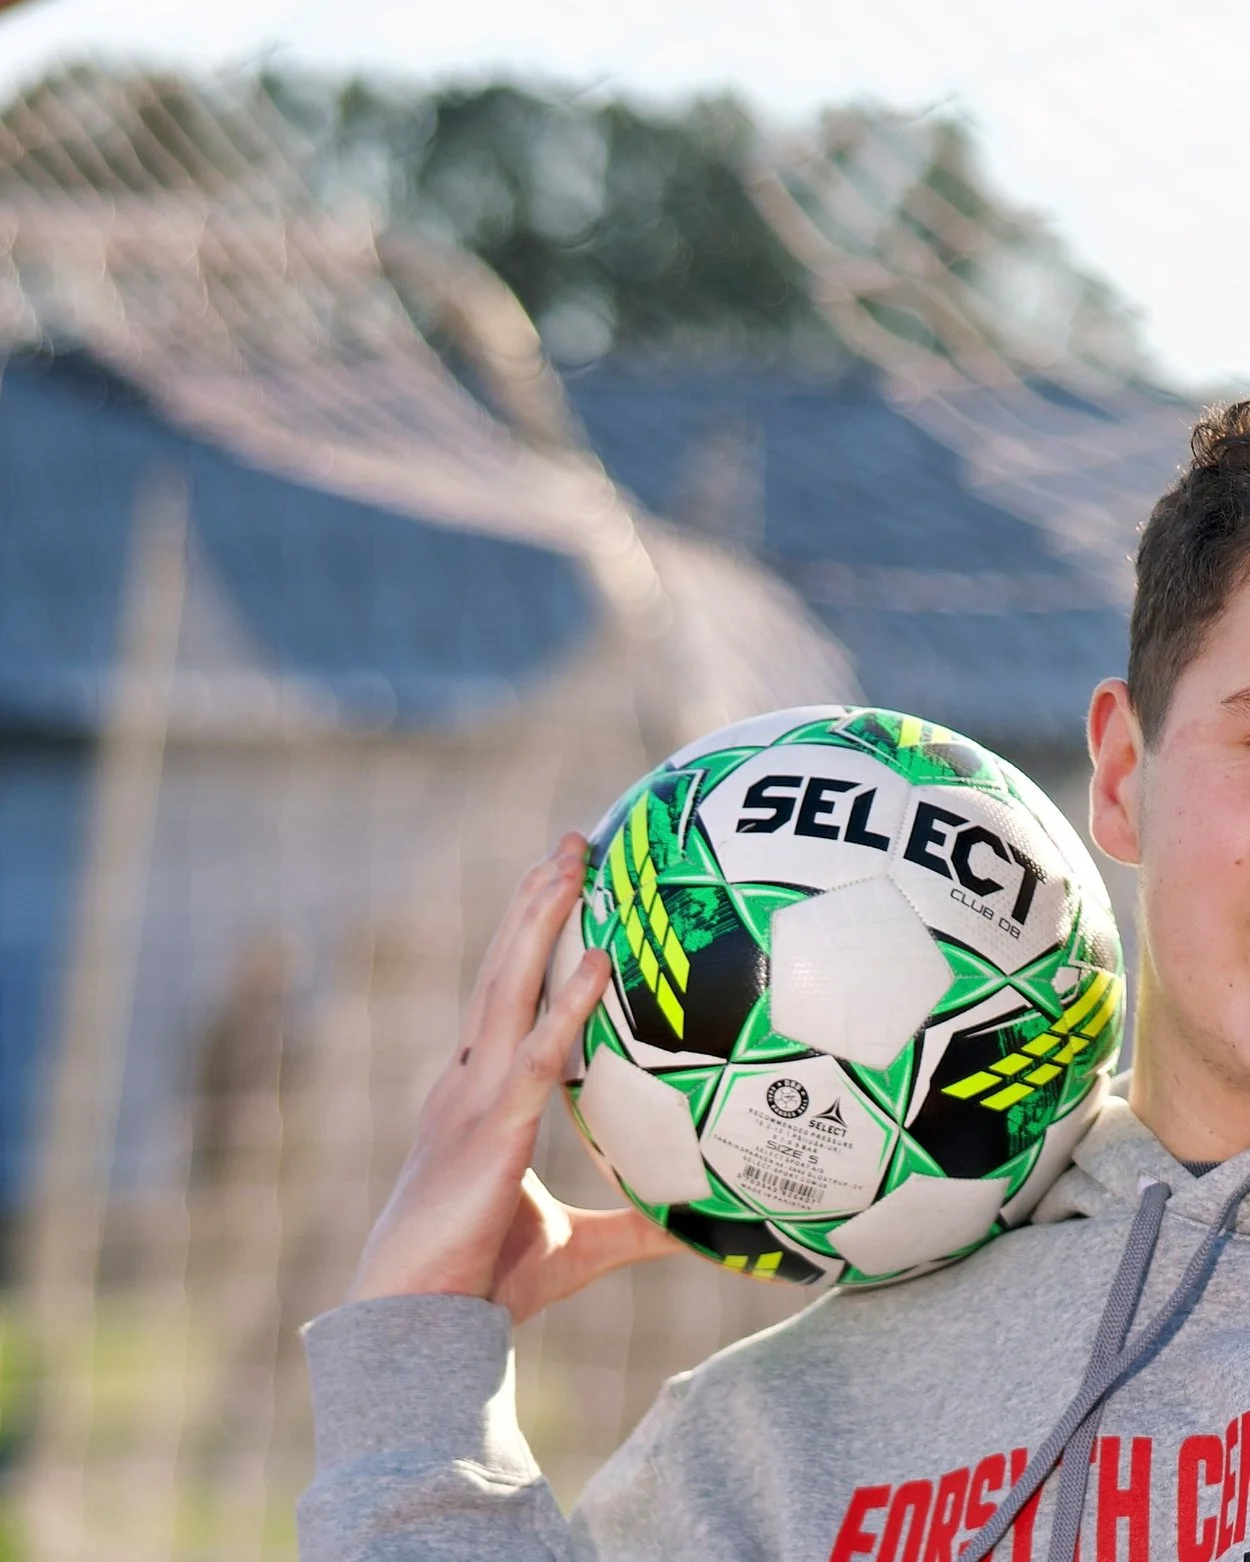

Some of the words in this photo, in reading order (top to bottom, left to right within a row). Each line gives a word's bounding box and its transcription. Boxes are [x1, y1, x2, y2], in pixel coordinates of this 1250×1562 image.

[736, 775, 1047, 925] SELECT
[949, 888, 994, 920] CLUB
[808, 1120, 847, 1138] SELECT
[766, 1140, 802, 1159] SIZE
